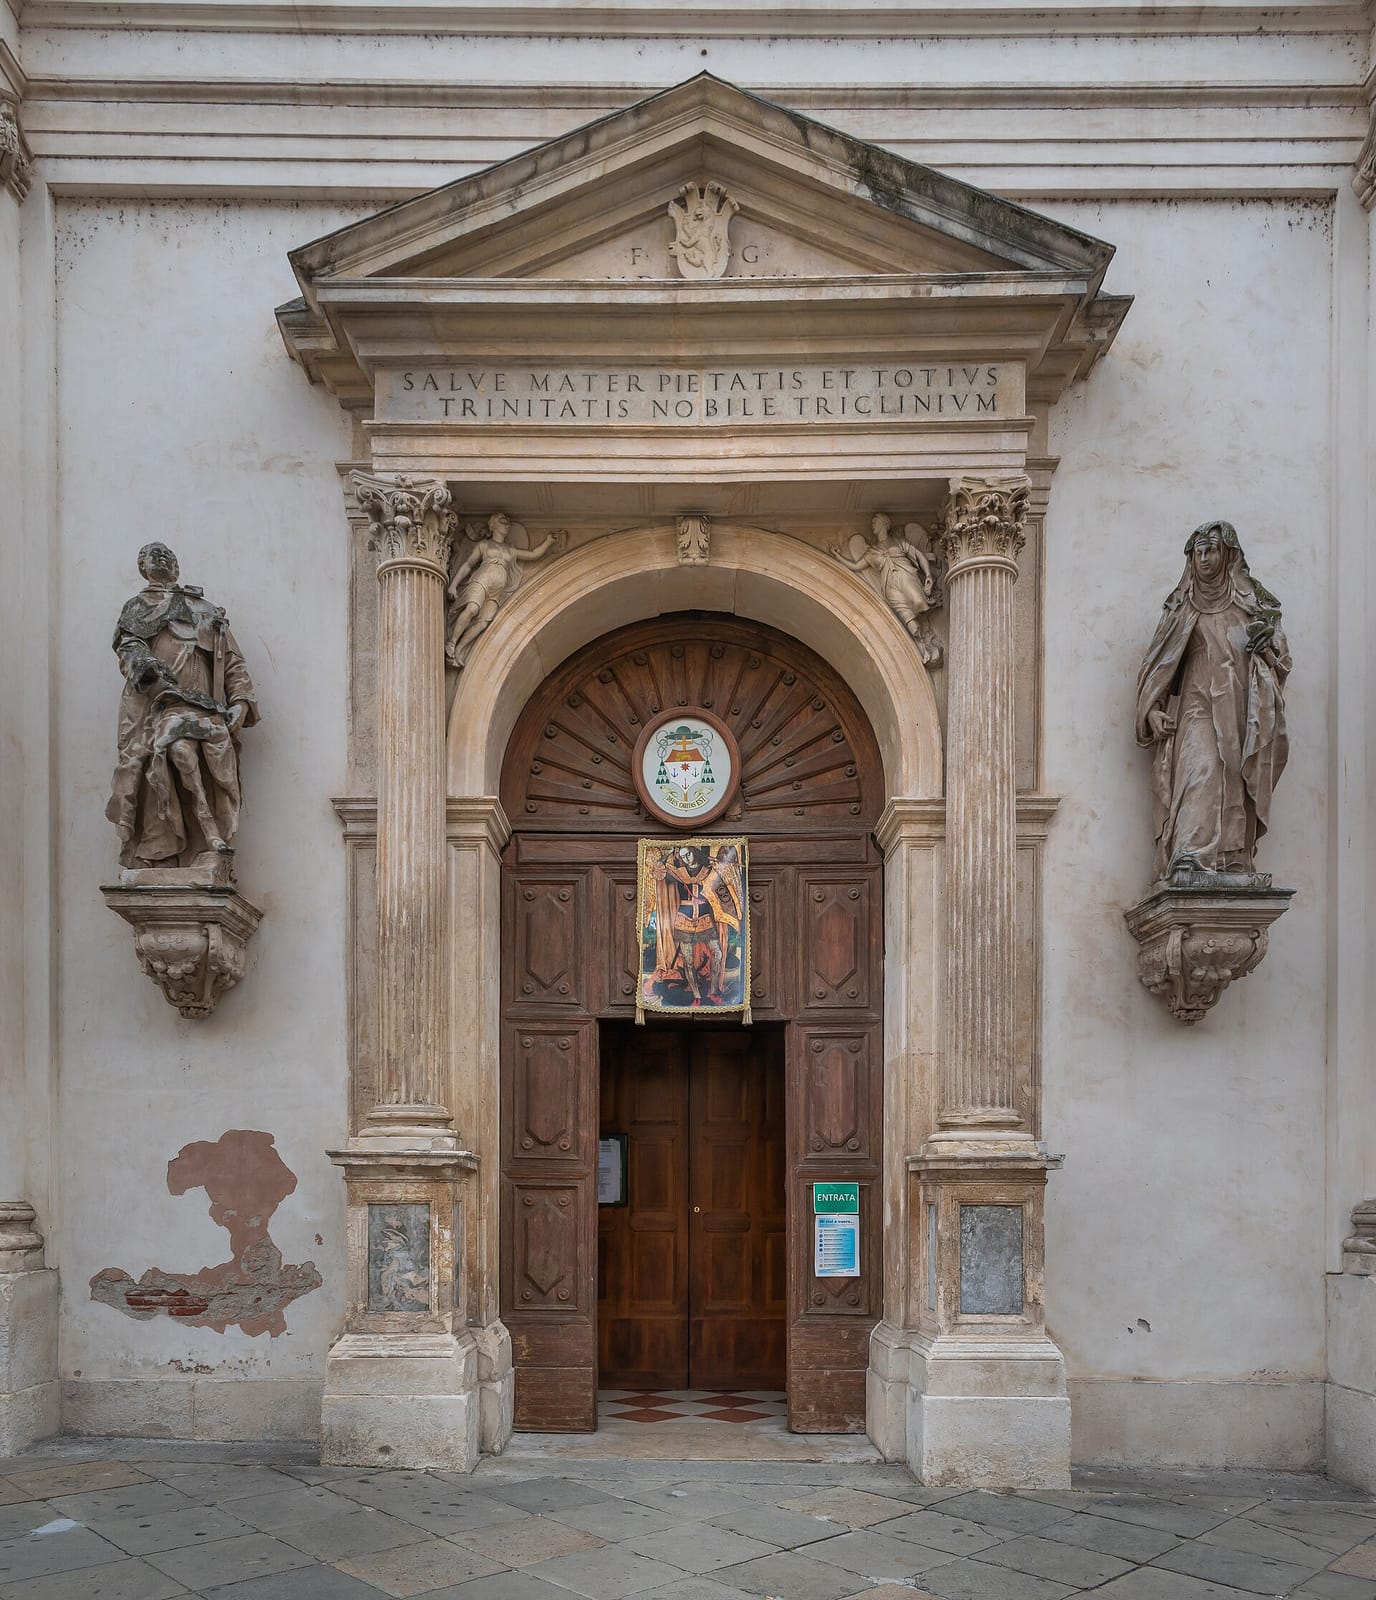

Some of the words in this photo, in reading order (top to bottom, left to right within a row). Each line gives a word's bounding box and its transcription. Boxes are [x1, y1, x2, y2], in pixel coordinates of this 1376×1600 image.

[402, 372, 506, 392] SALVE
[530, 373, 646, 393] MATER
[659, 371, 803, 393] PIETATIS
[822, 370, 856, 390] ET
[871, 367, 998, 389] TOTIVS
[439, 397, 630, 418] TRINITATIS
[652, 397, 777, 418] NOBILE
[793, 393, 998, 416] TRICLINIVM
[817, 1193, 856, 1201] ENTRATA
